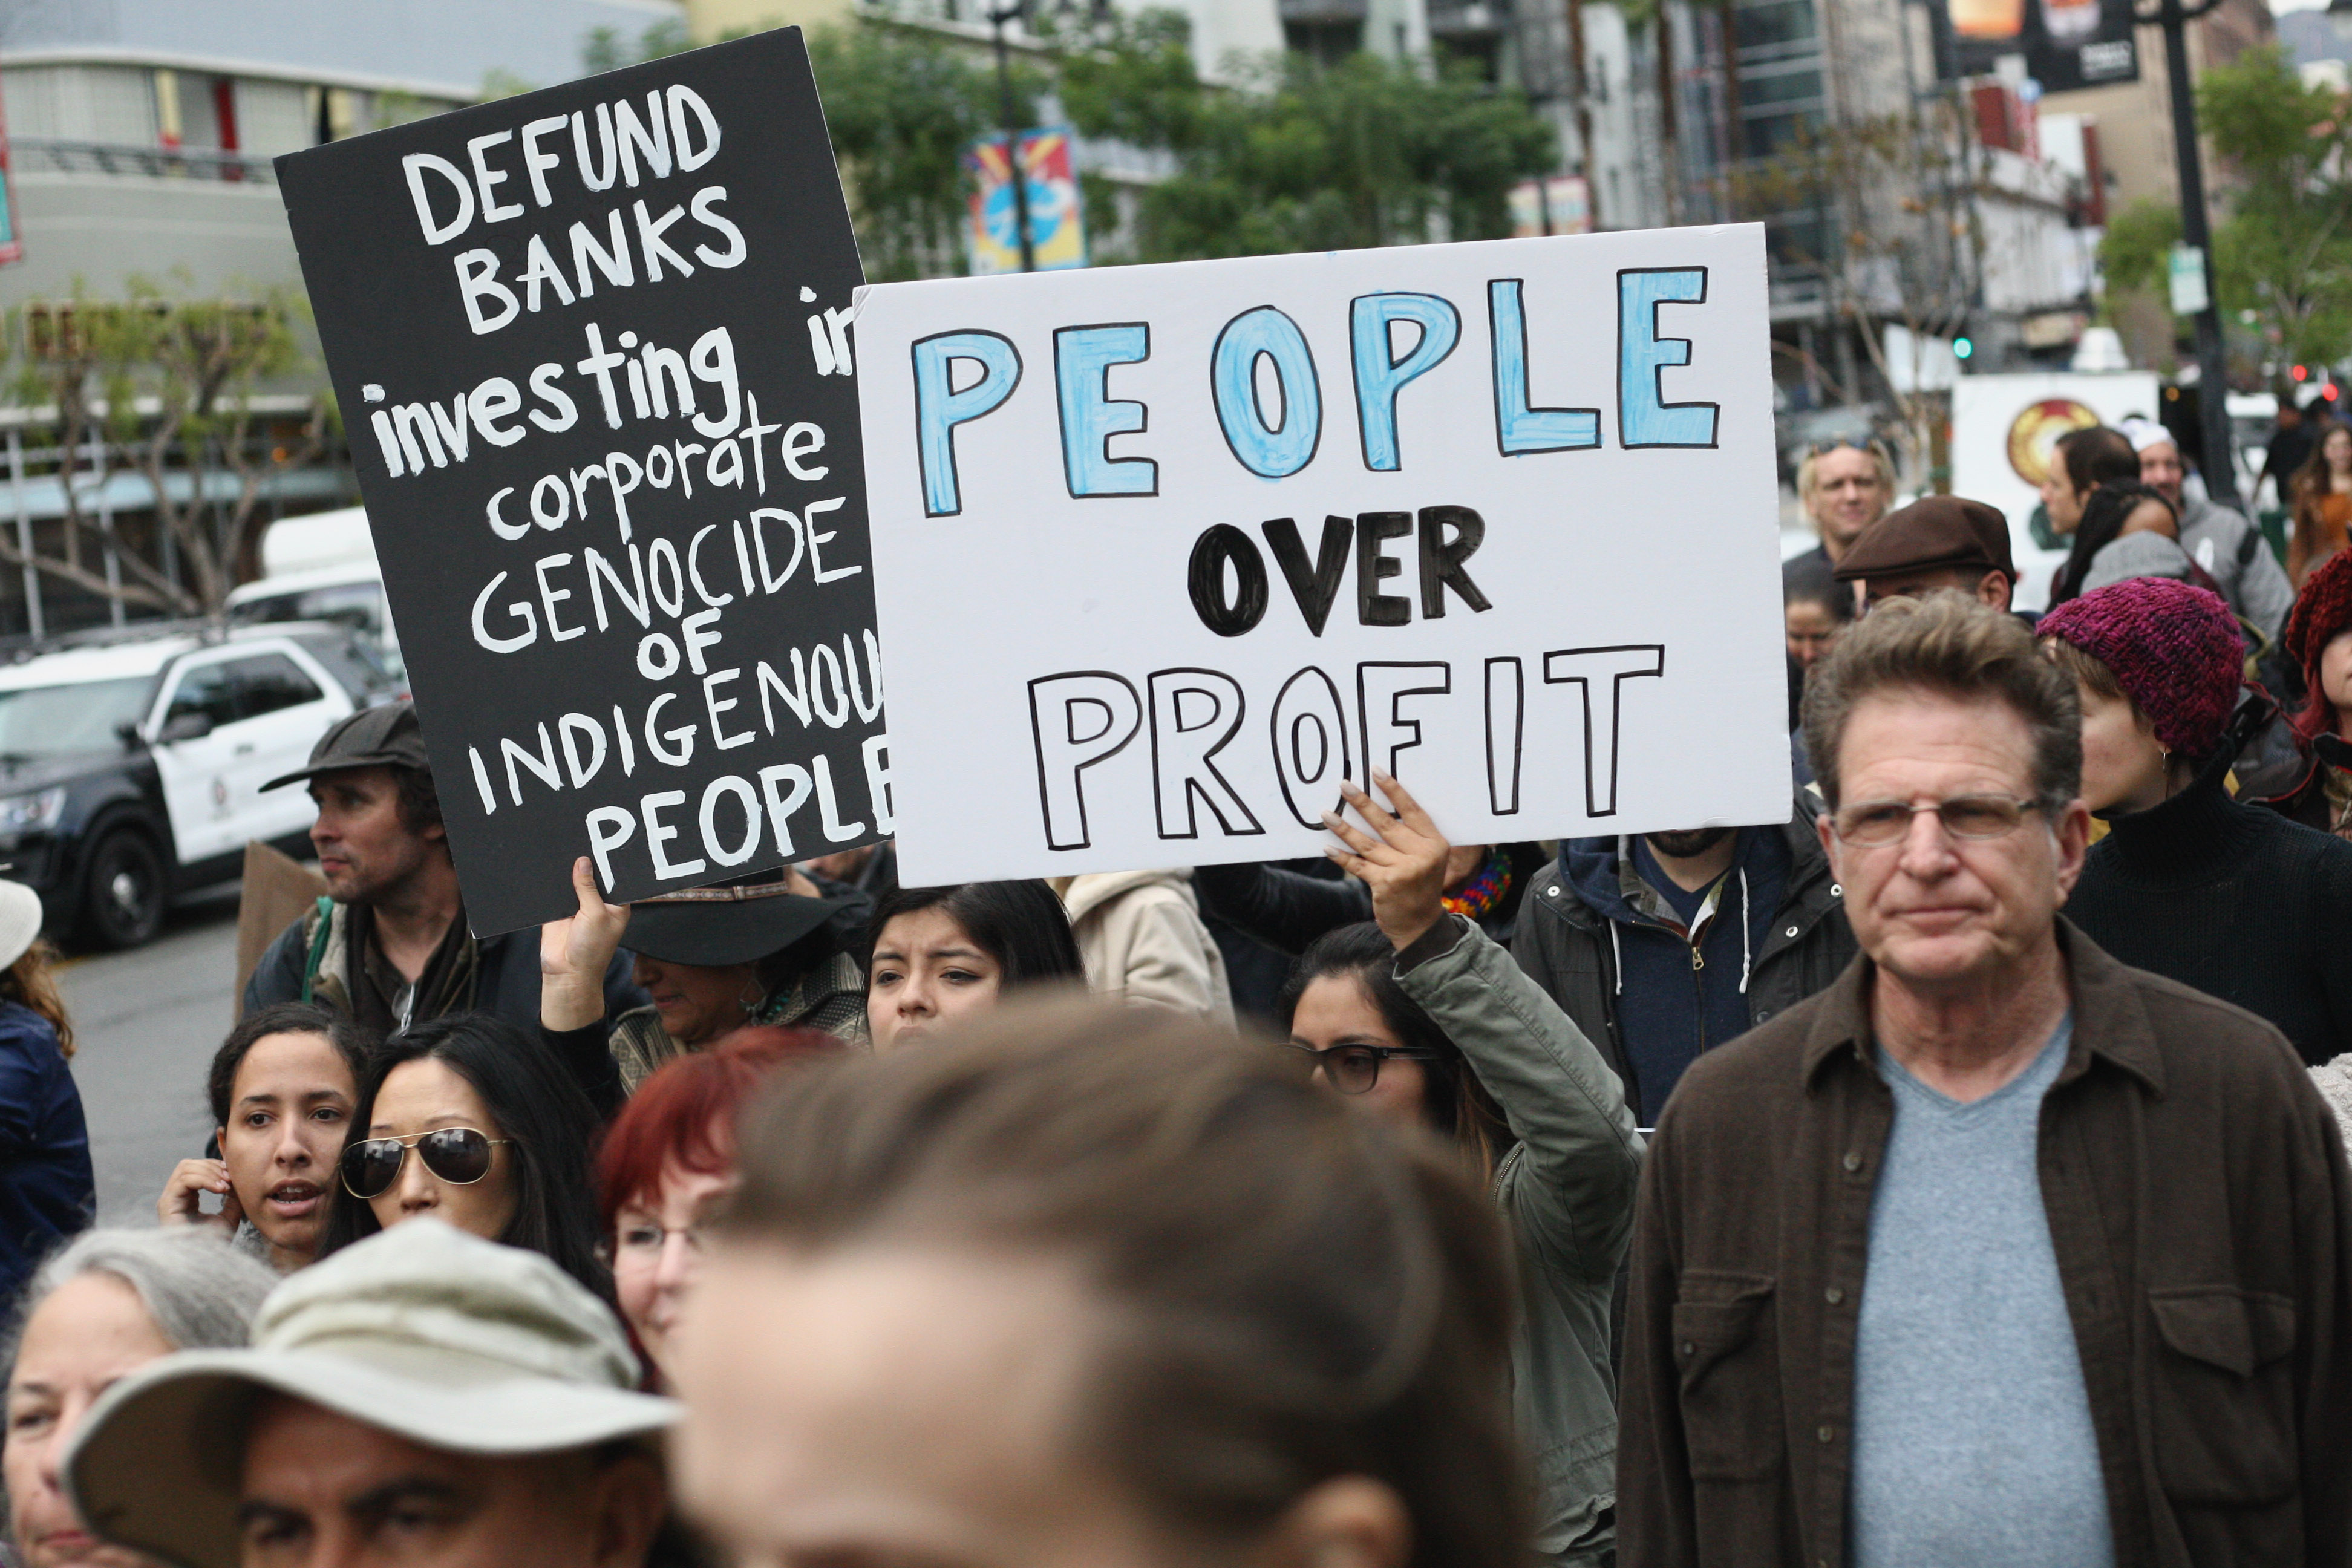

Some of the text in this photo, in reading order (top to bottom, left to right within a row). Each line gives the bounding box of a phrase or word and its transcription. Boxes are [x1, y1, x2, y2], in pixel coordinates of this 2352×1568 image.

[402, 83, 722, 246] DEFUND
[454, 186, 747, 335] BANKS
[362, 322, 742, 478] investing
[486, 390, 829, 544] corporate
[910, 265, 1722, 519] PEOPLE
[471, 496, 863, 654] GENOCIDE
[636, 607, 722, 681] OF
[1187, 505, 1493, 638] OVER
[1027, 644, 1665, 852] PROFIT
